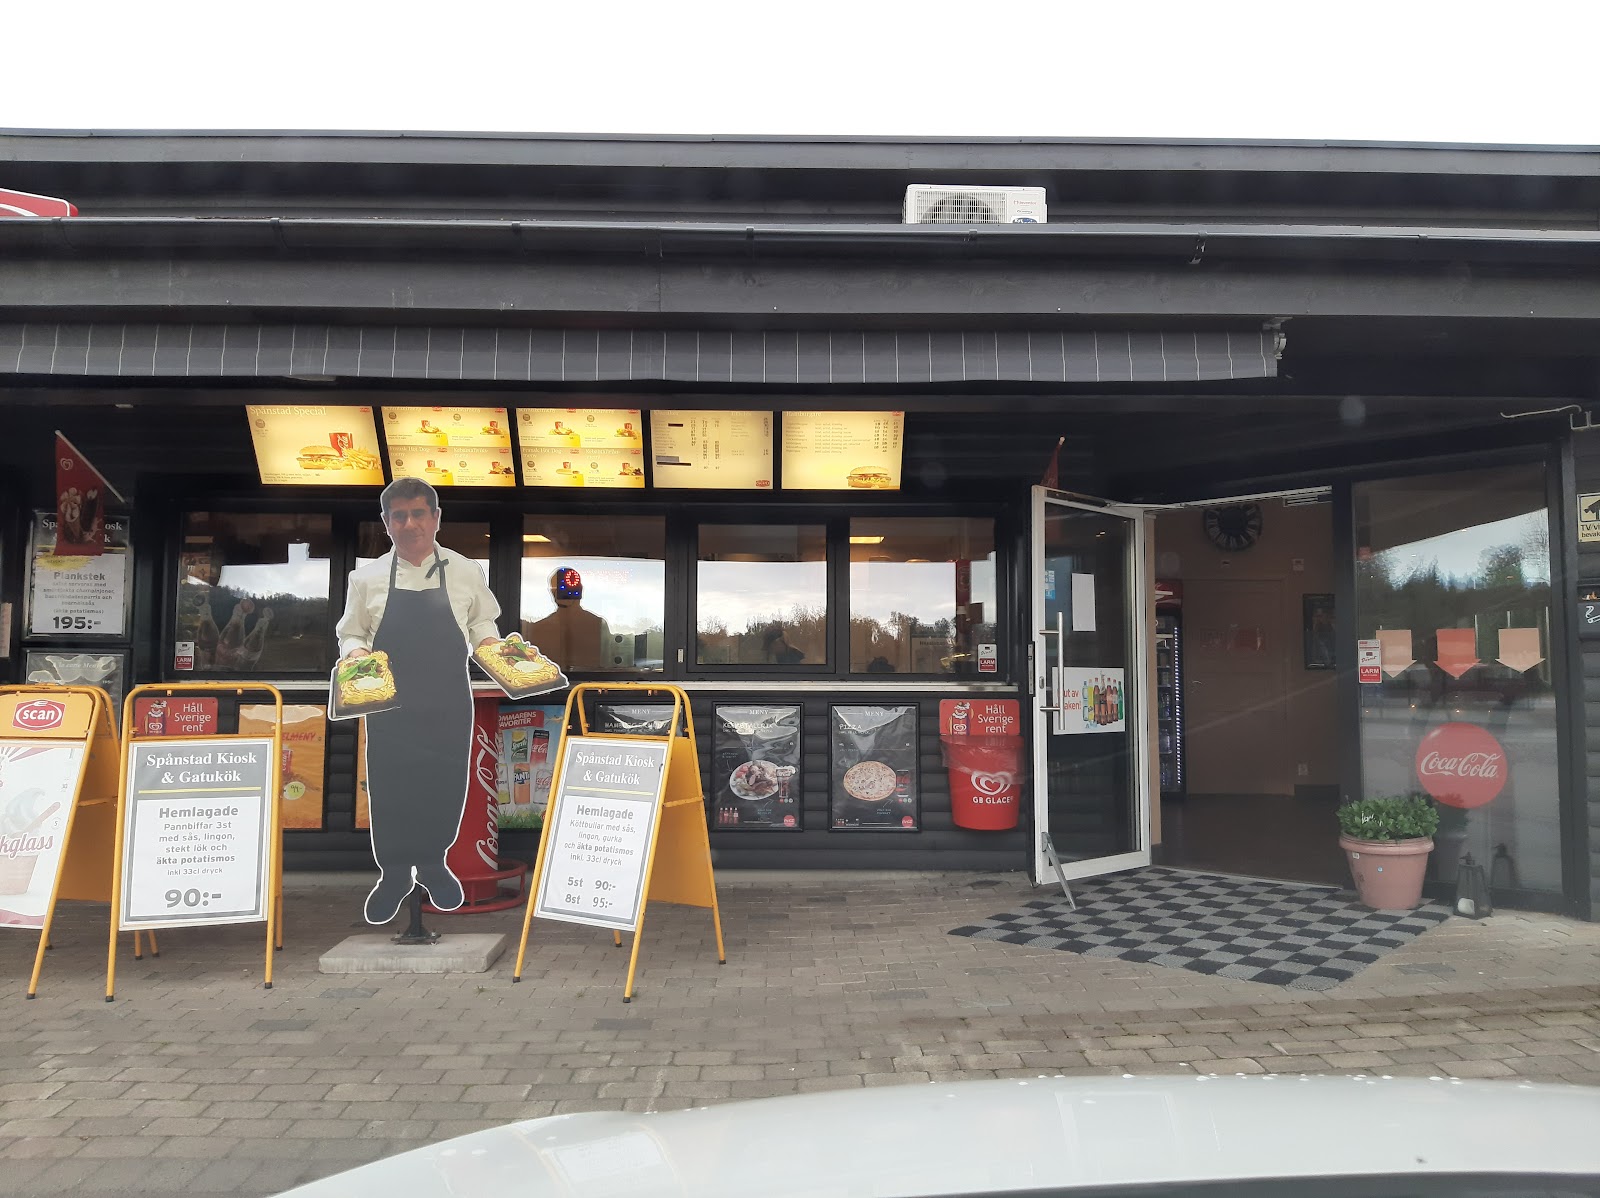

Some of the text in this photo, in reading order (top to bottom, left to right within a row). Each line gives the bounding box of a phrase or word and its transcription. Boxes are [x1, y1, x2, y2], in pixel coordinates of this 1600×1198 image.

[249, 406, 327, 417] Spånstad Special
[53, 571, 106, 581] Plankstek
[53, 616, 101, 630] 195:-
[1071, 690, 1079, 698] av
[183, 702, 204, 713] Håll
[985, 704, 1005, 714] Håll
[22, 709, 55, 721] scan
[174, 712, 211, 723] Sverige
[499, 711, 537, 722] MMARENS
[977, 714, 1014, 725] Sverige
[182, 724, 203, 732] rent
[499, 717, 532, 728] AVORITER
[985, 725, 1007, 734] rent
[146, 752, 257, 768] Spånstad Kiosk
[575, 751, 655, 768] Spånstad Kiosk
[1420, 751, 1502, 778] Coca-Cola
[161, 770, 241, 784] & Gatukök
[583, 770, 641, 785] & Gatukök
[476, 724, 499, 871] Coca-Cl
[972, 796, 1013, 804] GB GLACE
[159, 805, 239, 819] Hemlagade
[576, 805, 634, 820] Hemlagade
[164, 821, 232, 831] Pannbiffar 3st
[569, 820, 636, 834] Köttbullar med sås,
[159, 832, 235, 842] med sås, lingon,
[578, 831, 623, 843] lingon, gurka
[165, 845, 190, 853] stekt
[193, 843, 208, 852] lök
[577, 842, 593, 851] äkta
[594, 845, 634, 856] potatismos
[156, 855, 235, 865] äkta potatismos
[586, 855, 602, 863] 33cl
[603, 857, 622, 867] dryck
[201, 867, 223, 875] dryck
[567, 876, 616, 891] 5st 90:-
[164, 888, 222, 908] 90:-
[565, 893, 613, 909] 8st 95:-
